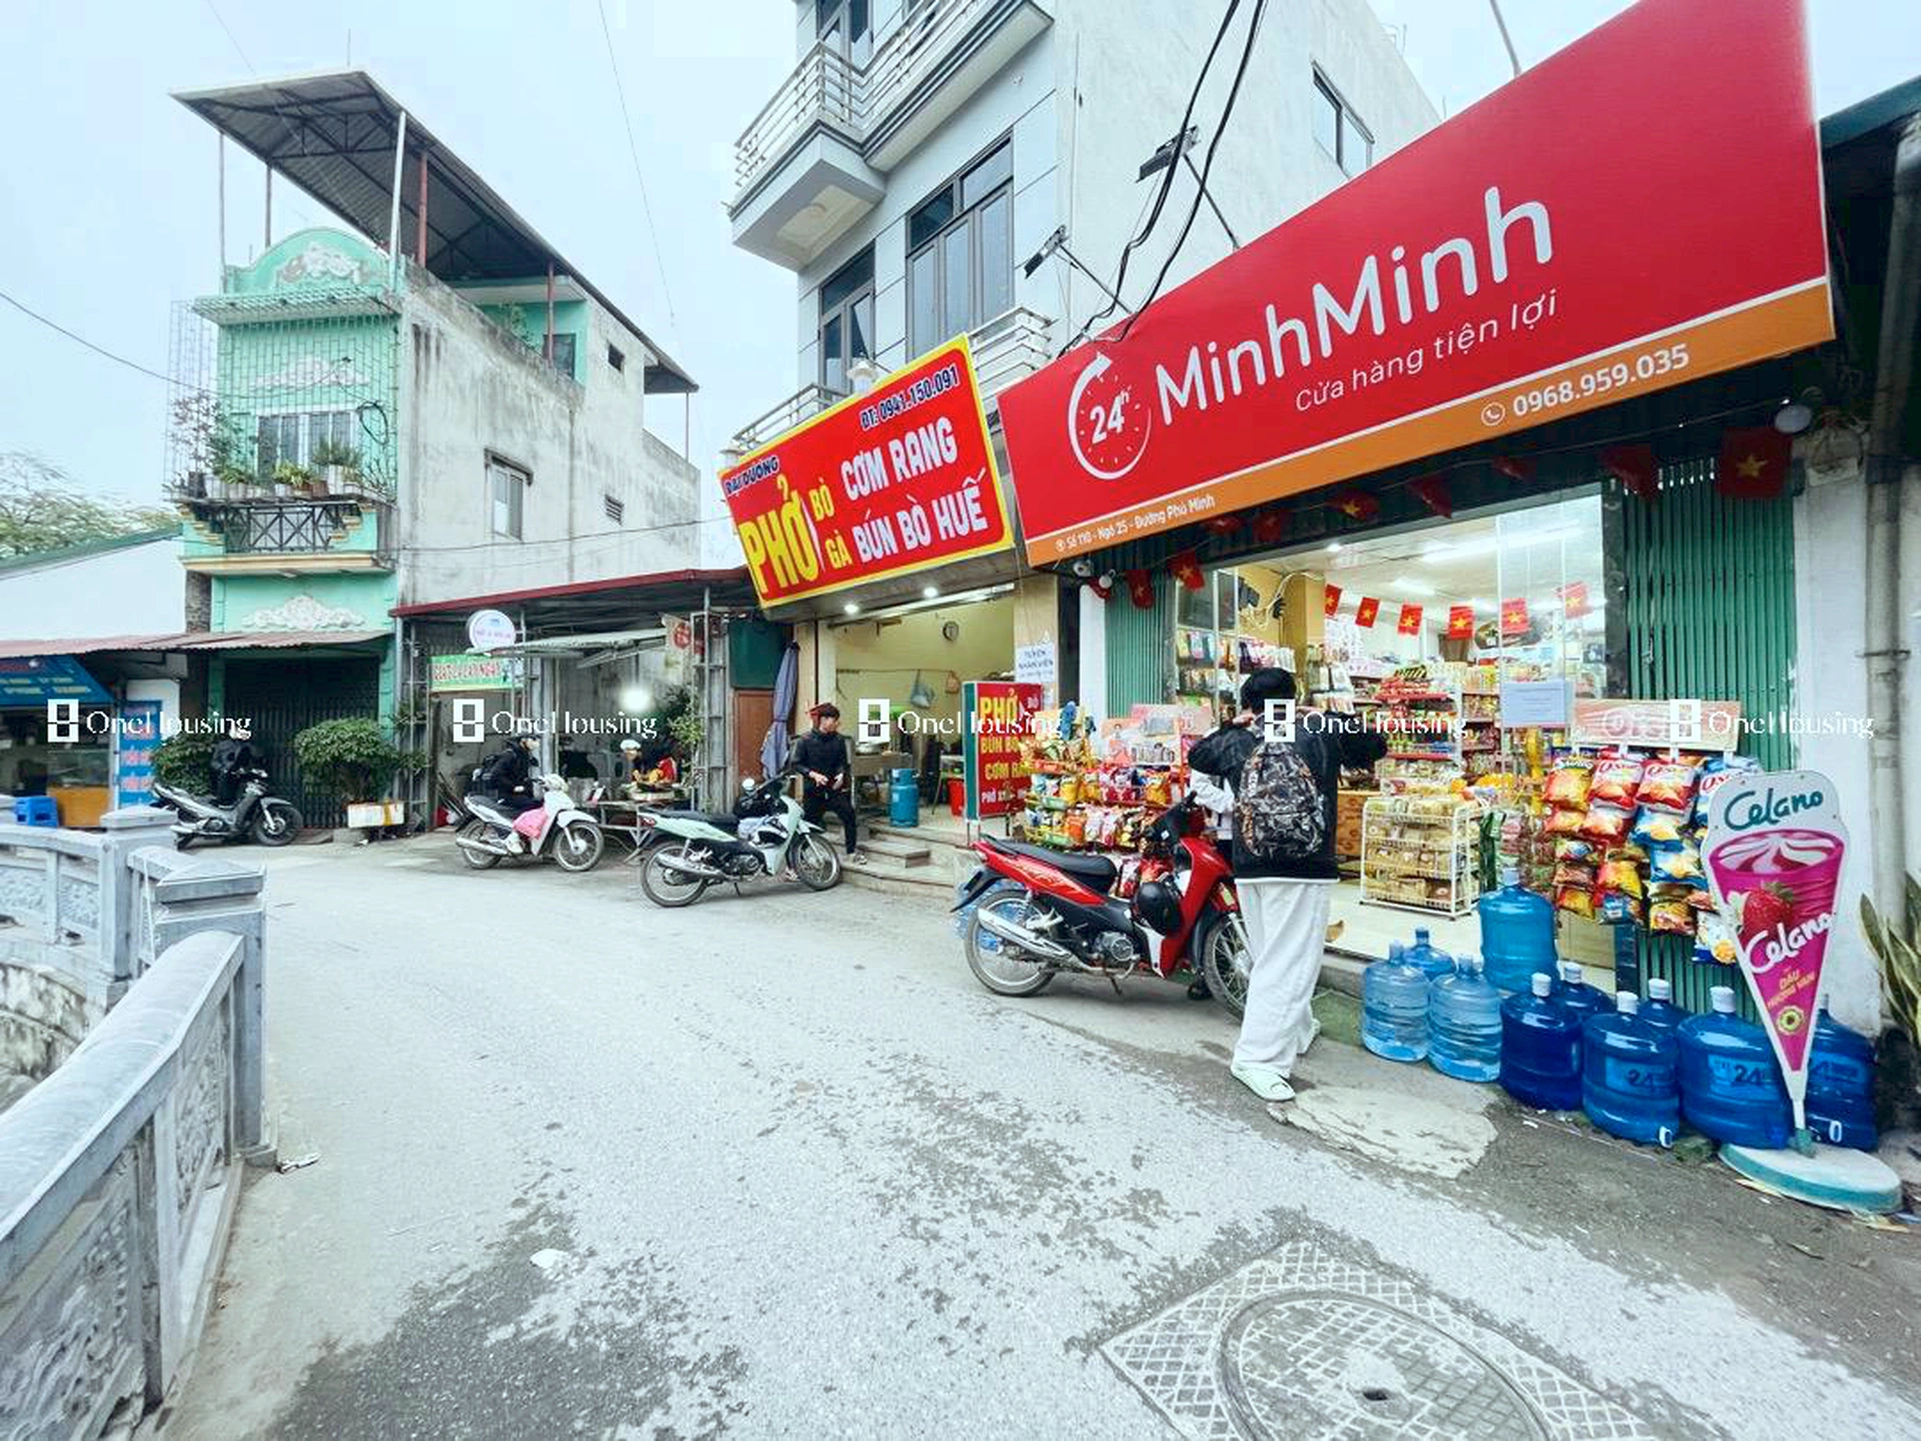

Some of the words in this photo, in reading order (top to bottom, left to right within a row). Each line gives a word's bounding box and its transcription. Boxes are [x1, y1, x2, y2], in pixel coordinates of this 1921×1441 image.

[1155, 186, 1553, 426] MinhMinh
[1295, 379, 1345, 411] Cửa
[1352, 347, 1424, 390] hàng
[1433, 320, 1499, 358] tiện
[1510, 288, 1557, 331] lợi
[1512, 342, 1691, 418] 0968.959.035
[840, 447, 890, 501] CƠM
[888, 416, 958, 481] RANG
[738, 473, 820, 594] PHỞ
[808, 476, 835, 521] BÒ
[852, 508, 898, 563] BÚN
[897, 493, 931, 550] BÒ
[932, 467, 987, 540] HUẾ
[1187, 494, 1216, 513] Minh
[825, 529, 853, 569] GÀ
[1723, 787, 1824, 831] Celano
[1745, 910, 1834, 975] Celano
